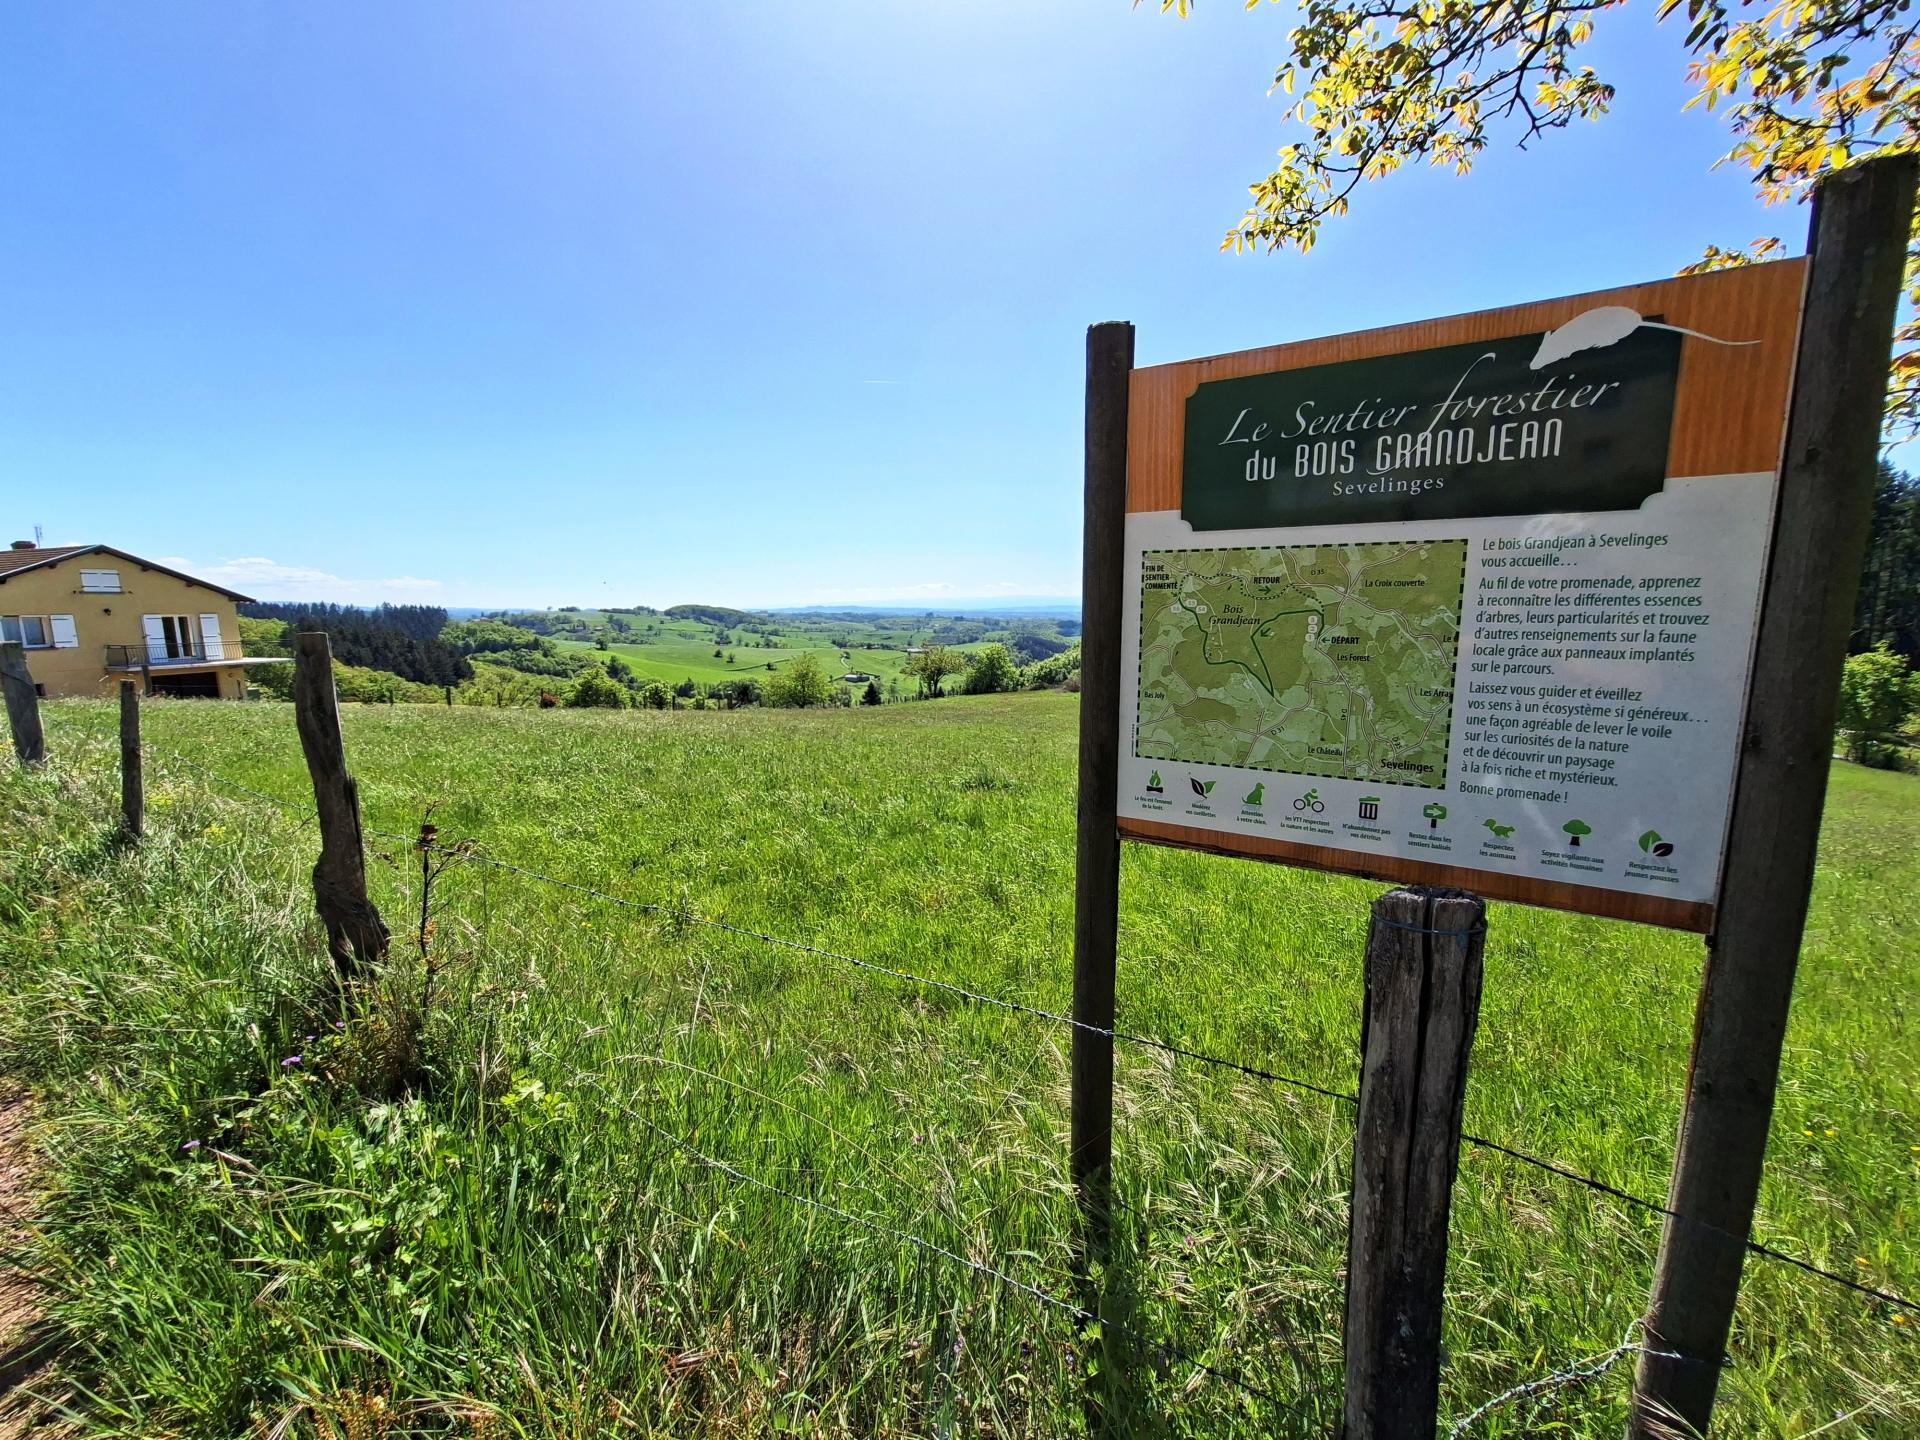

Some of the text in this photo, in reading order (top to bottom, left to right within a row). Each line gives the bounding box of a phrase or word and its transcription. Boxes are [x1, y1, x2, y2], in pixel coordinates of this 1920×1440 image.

[1219, 408, 1271, 446] Le
[1281, 398, 1418, 439] Sentier
[1245, 418, 1562, 482] du BOIS GRANDJEAN
[1333, 475, 1445, 497] Sevelinges
[1483, 532, 1669, 552] Le bois Grandjean à Sevelinges
[1481, 557, 1507, 567] vous
[1145, 573, 1170, 581] SENTIER
[1145, 581, 1178, 589] COMMENTÉ
[1253, 576, 1280, 584] RETOUR
[1365, 579, 1425, 587] La Croix couverte
[1479, 575, 1701, 592] Au fil de votre promenade, apprenez
[1477, 592, 1702, 607] à reconnaître les différentes essences
[1223, 604, 1244, 614] Bois
[1208, 615, 1261, 627] Grandjean
[1526, 611, 1555, 624] leurs
[1557, 611, 1640, 627] particularités
[1642, 612, 1657, 625] et
[1659, 613, 1709, 625] trouvez
[1331, 635, 1360, 645] DÉPART
[1521, 628, 1617, 644] renseignements
[1620, 631, 1641, 643] sur
[1643, 629, 1655, 643] la
[1658, 629, 1697, 643] faune
[1337, 653, 1370, 662] Les Forest
[1473, 643, 1695, 664] locale grâce aux panneaux implantés
[1471, 660, 1555, 676] sur le parcours.
[1420, 688, 1432, 696] Les
[1469, 681, 1642, 701] Laissez vous guider et éveillez
[1468, 700, 1485, 709] vos
[1488, 700, 1512, 711] sens
[1515, 699, 1521, 712] à
[1524, 703, 1539, 712] un
[1542, 701, 1611, 718] écosystème
[1614, 705, 1625, 717] si
[1466, 714, 1672, 738] une façon agréable de lever le voile
[1464, 730, 1629, 752] sur les curiosités de la nature
[1316, 745, 1343, 756] Château
[1463, 746, 1615, 771] et de découvrir un paysage
[1380, 759, 1434, 773] Sevelinges
[1461, 760, 1618, 787] à la fois riche et mystérieux.
[1459, 781, 1494, 795] Bonne
[1496, 787, 1561, 803] promenade
[1629, 861, 1678, 874] Respectez les
